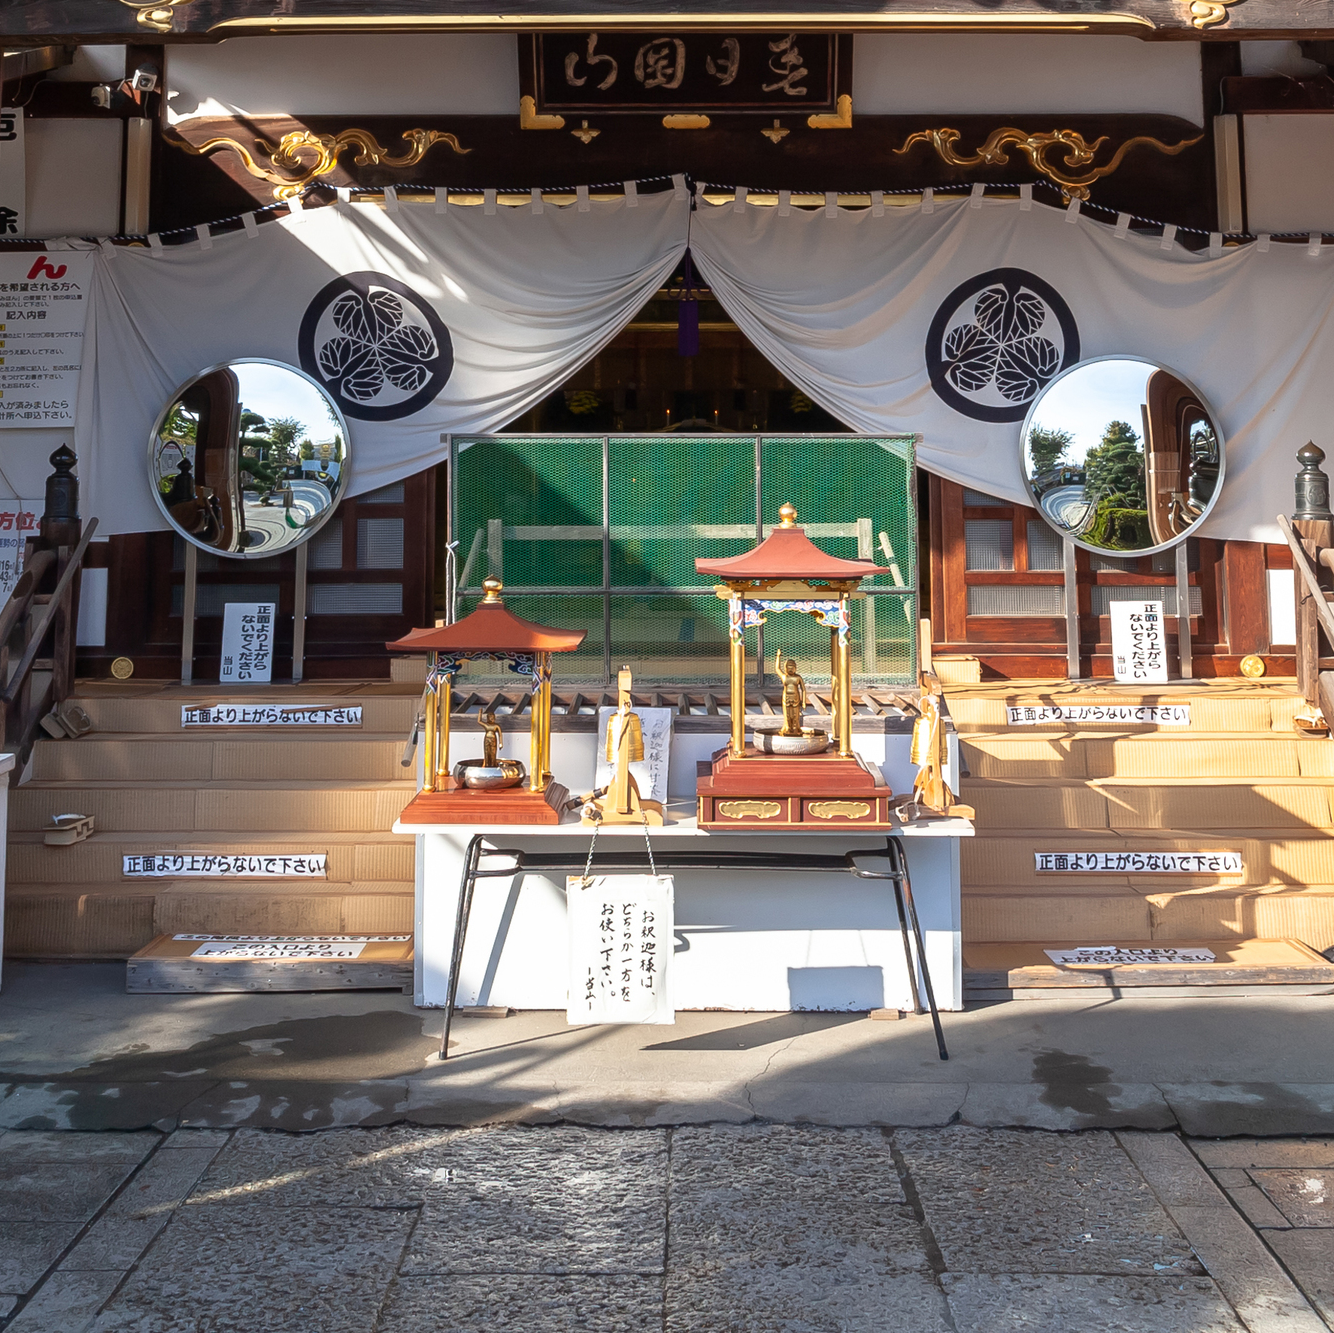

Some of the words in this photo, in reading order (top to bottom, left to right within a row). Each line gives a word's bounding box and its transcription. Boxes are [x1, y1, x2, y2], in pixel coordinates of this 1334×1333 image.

[6, 311, 47, 320] 記入内容
[223, 656, 233, 675] 当山
[238, 615, 255, 680] ないでください
[254, 606, 271, 670] 正面より上がら
[1130, 614, 1147, 678] ないでください
[1144, 604, 1161, 669] 正面より上がら
[185, 708, 359, 724] 正面より上がらないで下さい
[1010, 708, 1186, 722] 正面より上がらないで下さい
[127, 856, 322, 873] 正面より上がらないで下さい
[1039, 854, 1238, 871] 正面より上がらないで下さい
[599, 903, 616, 997] お使い下さい。
[620, 903, 638, 1002] どちらか一方を
[639, 910, 657, 995] お釈迦様は、
